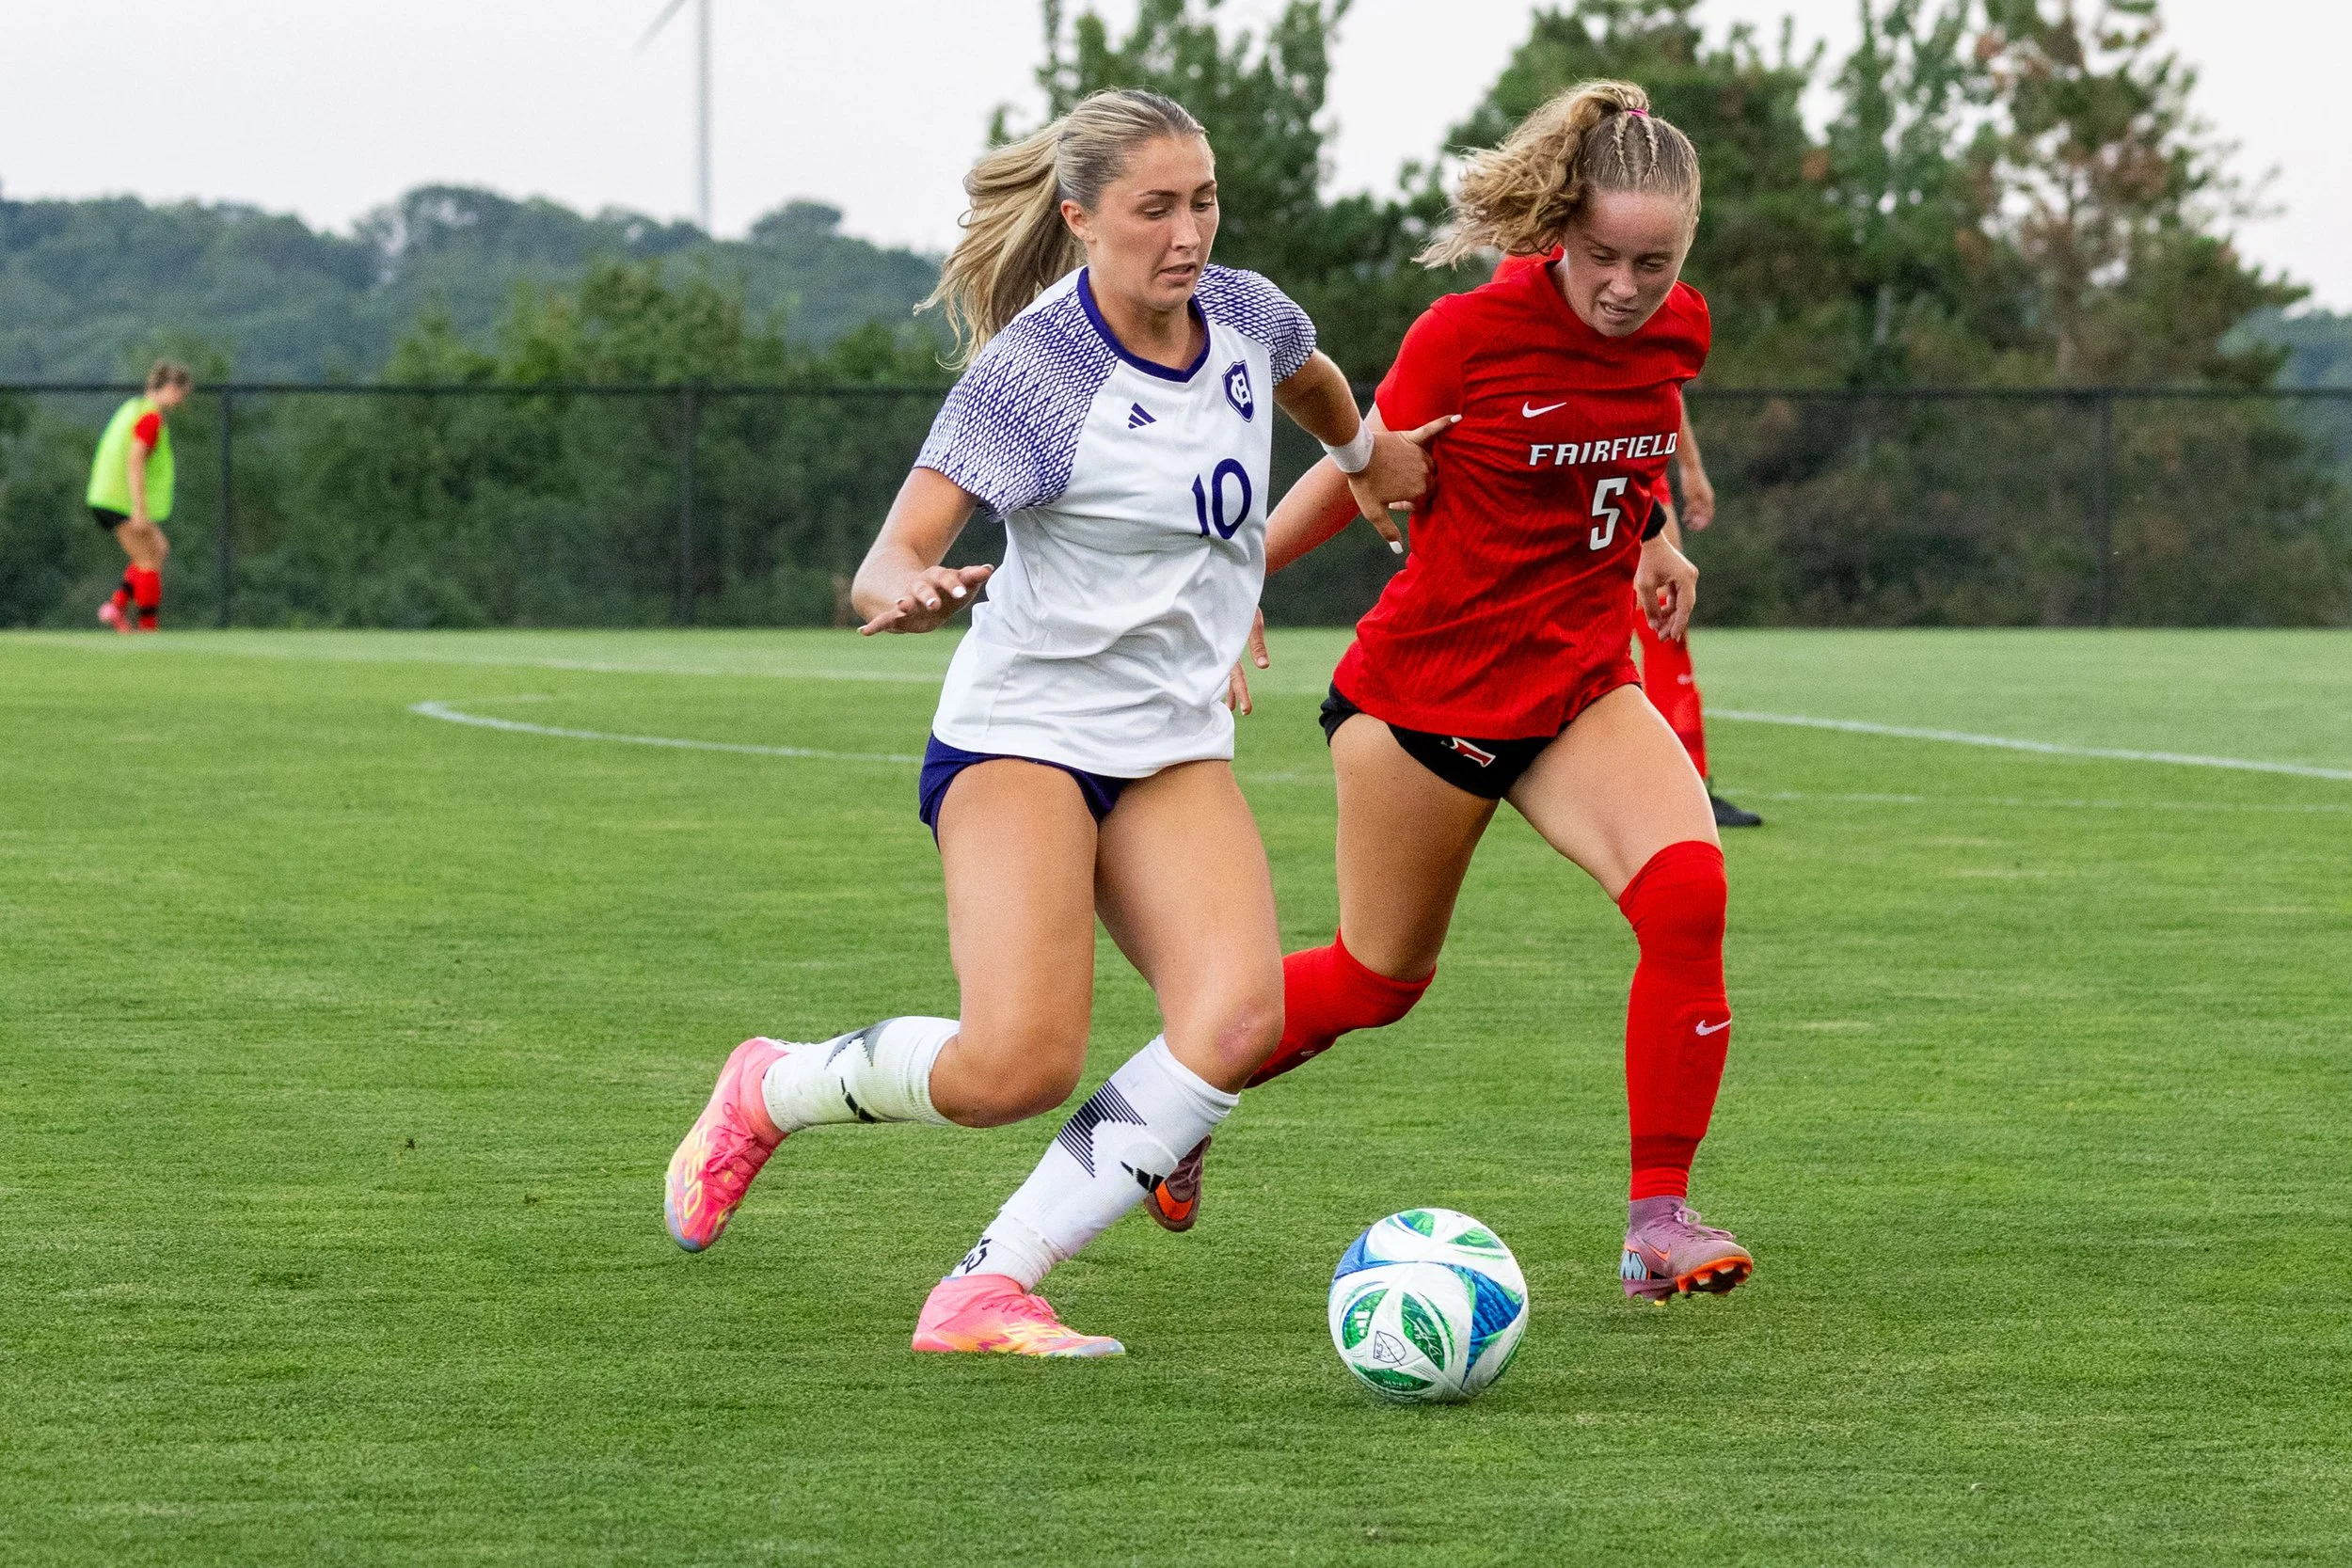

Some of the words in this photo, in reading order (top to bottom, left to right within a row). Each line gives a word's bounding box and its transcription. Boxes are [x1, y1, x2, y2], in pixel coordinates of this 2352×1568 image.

[1529, 432, 1678, 467] FAIRFIELD
[1191, 458, 1252, 540] 10
[1589, 477, 1629, 550] 5
